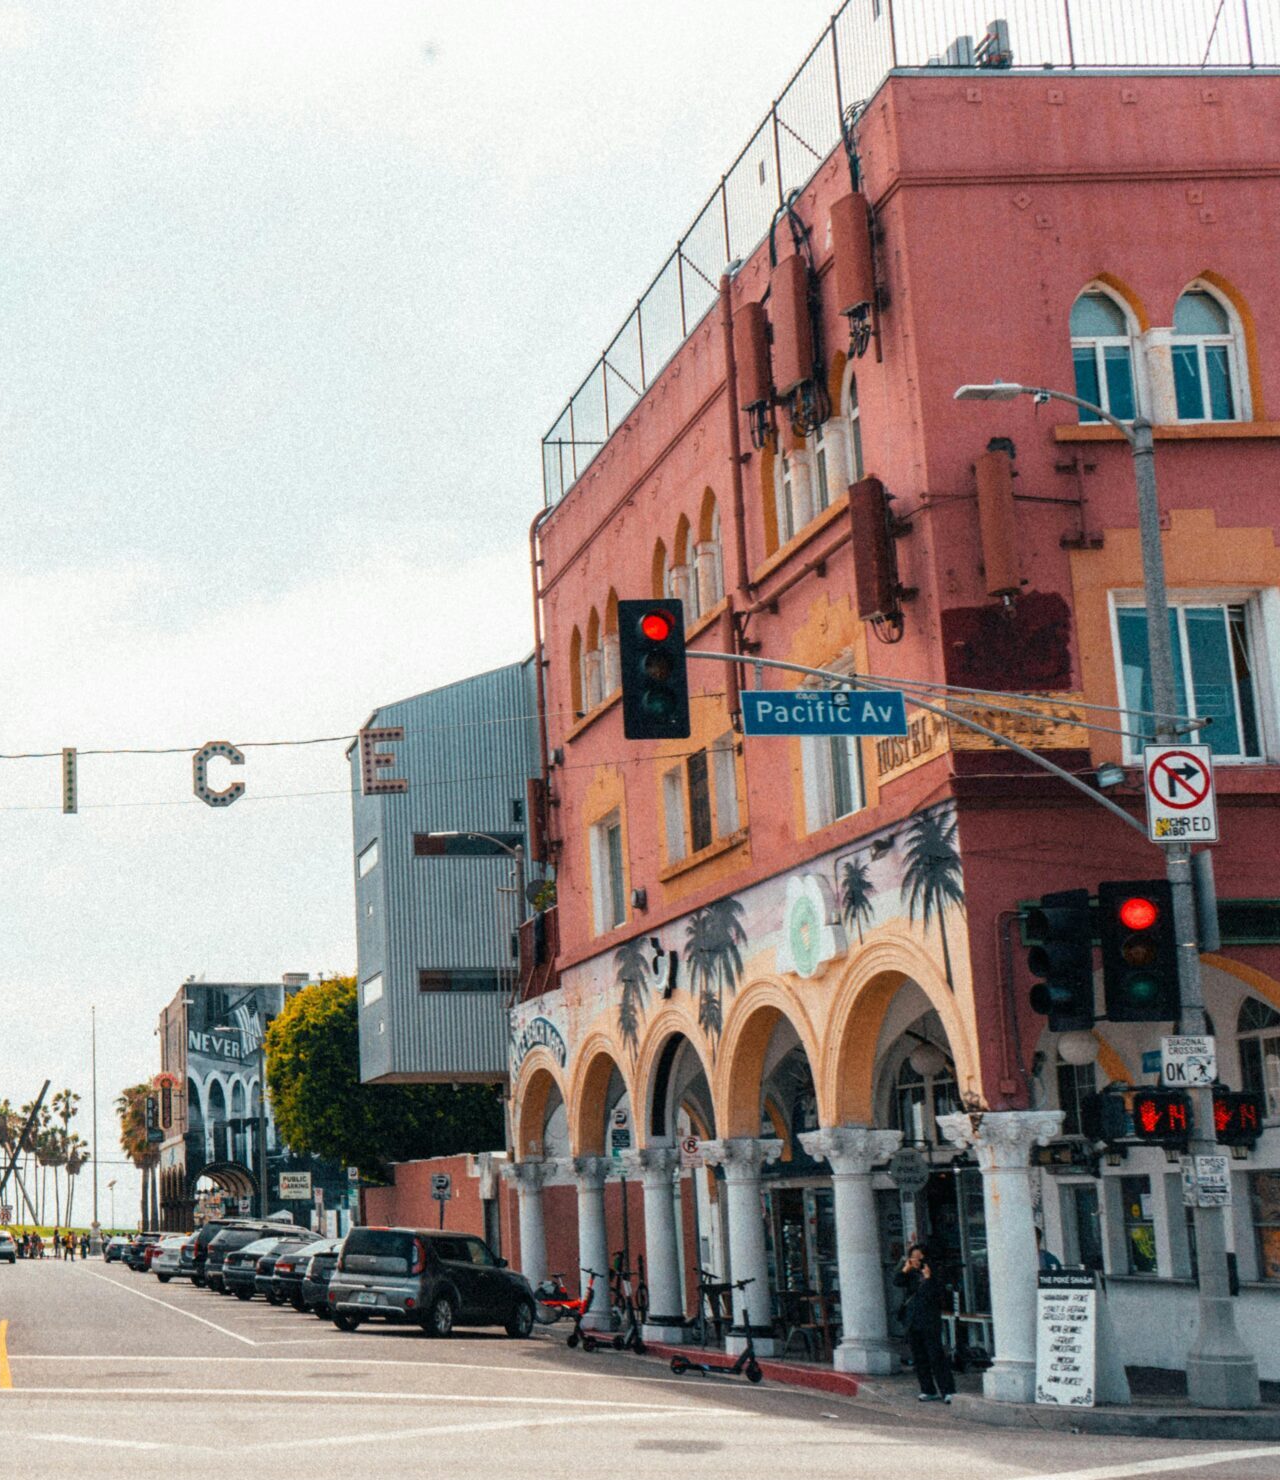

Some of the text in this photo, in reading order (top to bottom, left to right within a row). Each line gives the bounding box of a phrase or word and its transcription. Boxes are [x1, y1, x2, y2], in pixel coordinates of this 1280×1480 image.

[756, 701, 893, 723] Pacific Av
[1183, 816, 1211, 831] RED
[188, 1030, 240, 1058] NEVER
[1168, 1038, 1206, 1046] DIAGONAL
[1168, 1046, 1208, 1055] CROSSING
[1166, 1062, 1186, 1081] OK
